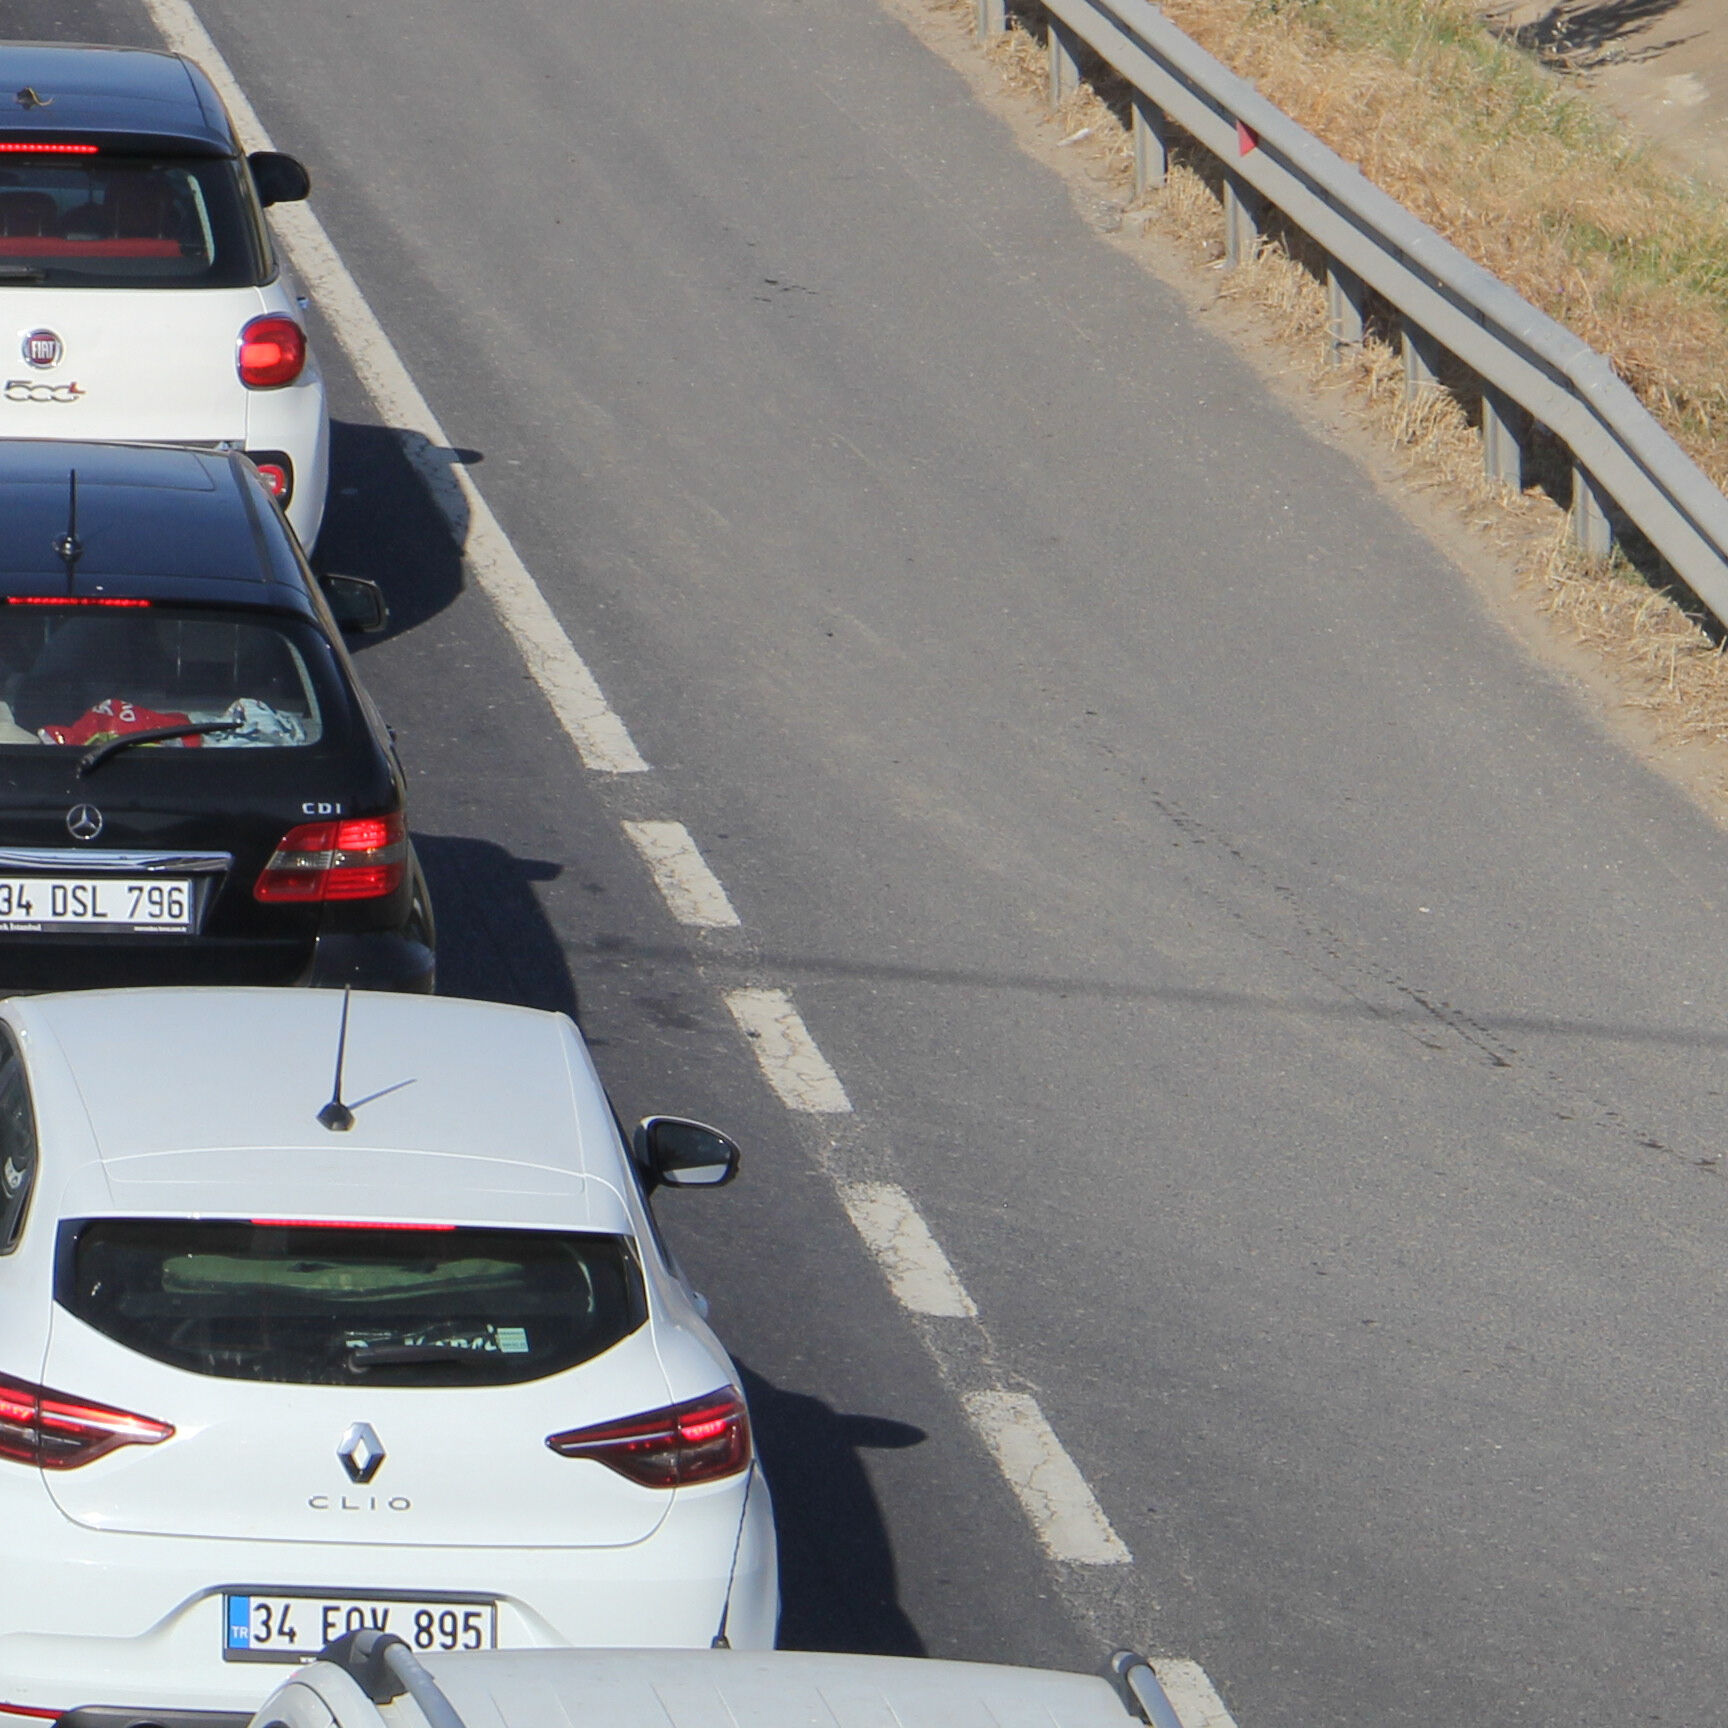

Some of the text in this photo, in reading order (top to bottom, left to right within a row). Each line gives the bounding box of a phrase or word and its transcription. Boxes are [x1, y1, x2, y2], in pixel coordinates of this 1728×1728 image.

[31, 340, 55, 360] FIAT
[302, 802, 341, 815] CDI
[51, 884, 108, 918] DSL
[127, 886, 184, 920] 796
[308, 1496, 411, 1510] CLIO
[232, 1626, 248, 1639] TR
[252, 1603, 297, 1644] 34
[413, 1609, 482, 1651] 895
